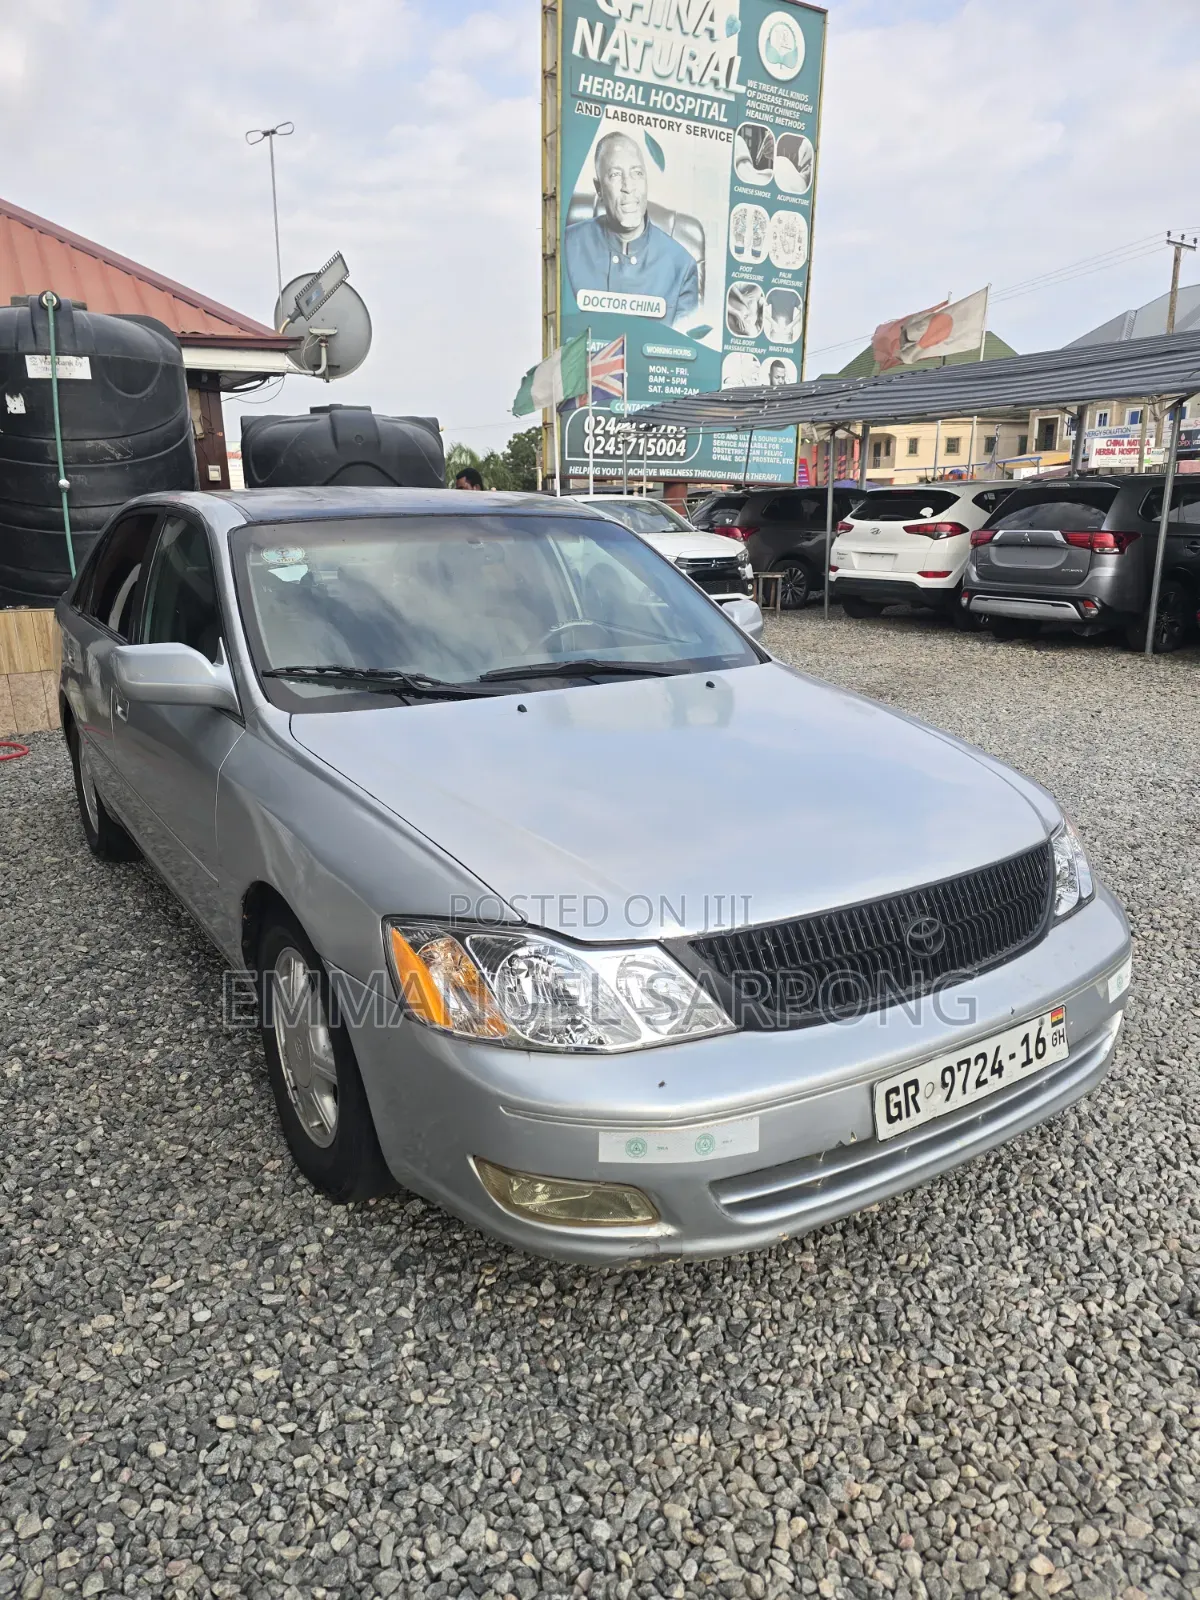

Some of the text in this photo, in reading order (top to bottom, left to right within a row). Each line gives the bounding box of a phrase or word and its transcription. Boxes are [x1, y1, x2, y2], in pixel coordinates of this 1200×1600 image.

[572, 17, 746, 94] NATURAL
[747, 79, 809, 102] WE TREAT ALL KINDS
[578, 73, 728, 122] HERBAL HOSPITAL
[747, 89, 813, 113] OF DISEASE THROUGH
[746, 100, 800, 119] ANCIENT CHINESE
[576, 102, 733, 143] AND LABORATORY SERVICE
[745, 109, 806, 130] HEALING METHODS
[734, 186, 771, 199] CHINESE SMOKE
[777, 194, 809, 206] ACUPUNCTURE
[731, 271, 764, 281] ACUPRESSURE
[771, 278, 803, 287] ACUPRESSURE
[583, 295, 661, 313] DOCTOR CHINA
[646, 345, 692, 357] WORKING HOURS
[649, 365, 669, 374] MON.
[675, 367, 690, 376] FRI.
[648, 375, 666, 384] 8AM
[671, 377, 687, 385] 5PM
[648, 385, 664, 393] SAT.
[1103, 426, 1131, 436] SOLUTION
[739, 434, 758, 442] ULTA
[1106, 439, 1124, 447] CHINA
[712, 447, 744, 455] OBSTETRIC
[738, 441, 767, 449] AVALABLE
[1095, 447, 1117, 456] HERBAL
[712, 454, 732, 462] GYNAE
[601, 467, 617, 476] YOU
[659, 468, 693, 477] WELLNESS
[694, 469, 727, 479] THROUGH
[751, 472, 777, 481] THERAPY
[1052, 1028, 1065, 1047] GH
[885, 1027, 1047, 1124] GR 9724-16
